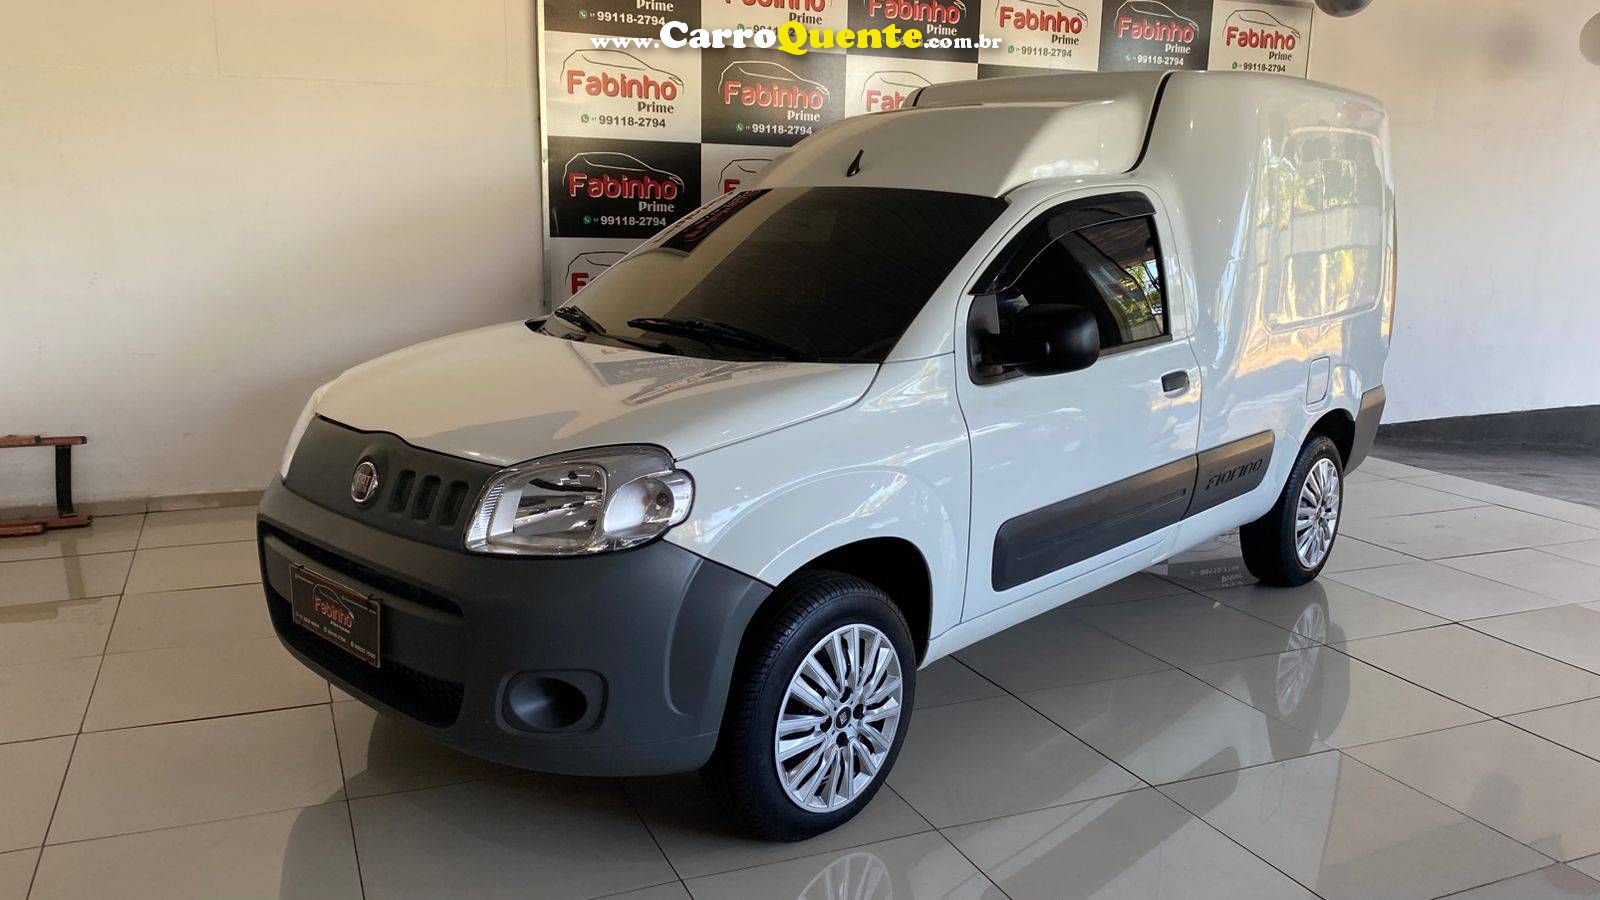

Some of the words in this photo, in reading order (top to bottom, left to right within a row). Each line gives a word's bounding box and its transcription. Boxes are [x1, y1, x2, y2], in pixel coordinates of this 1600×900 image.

[636, 0, 674, 12] Prime
[868, 0, 961, 24] Fabinho
[597, 10, 666, 26] 99118-2794
[788, 12, 823, 25] Prime
[999, 6, 1083, 34] Fabinho
[926, 23, 958, 37] Prime
[1117, 16, 1195, 43] Fabinho
[1051, 34, 1080, 46] Prime
[1225, 26, 1296, 51] Fabinho
[1021, 46, 1072, 58] 99118-2794
[1164, 42, 1191, 54] Prime
[1137, 54, 1184, 66] 99118-2794
[1268, 51, 1293, 61] Prime
[1243, 62, 1286, 72] 99118-2794
[566, 69, 677, 101] Fabinho
[723, 80, 824, 110] Fabinho
[637, 101, 675, 115] Prime
[599, 115, 666, 128] 99118-2794
[787, 110, 821, 122] Prime
[751, 123, 813, 135] 99118-2794
[568, 172, 678, 200] Fabinho
[638, 201, 675, 213] Prime
[600, 216, 667, 227] 99118-2794
